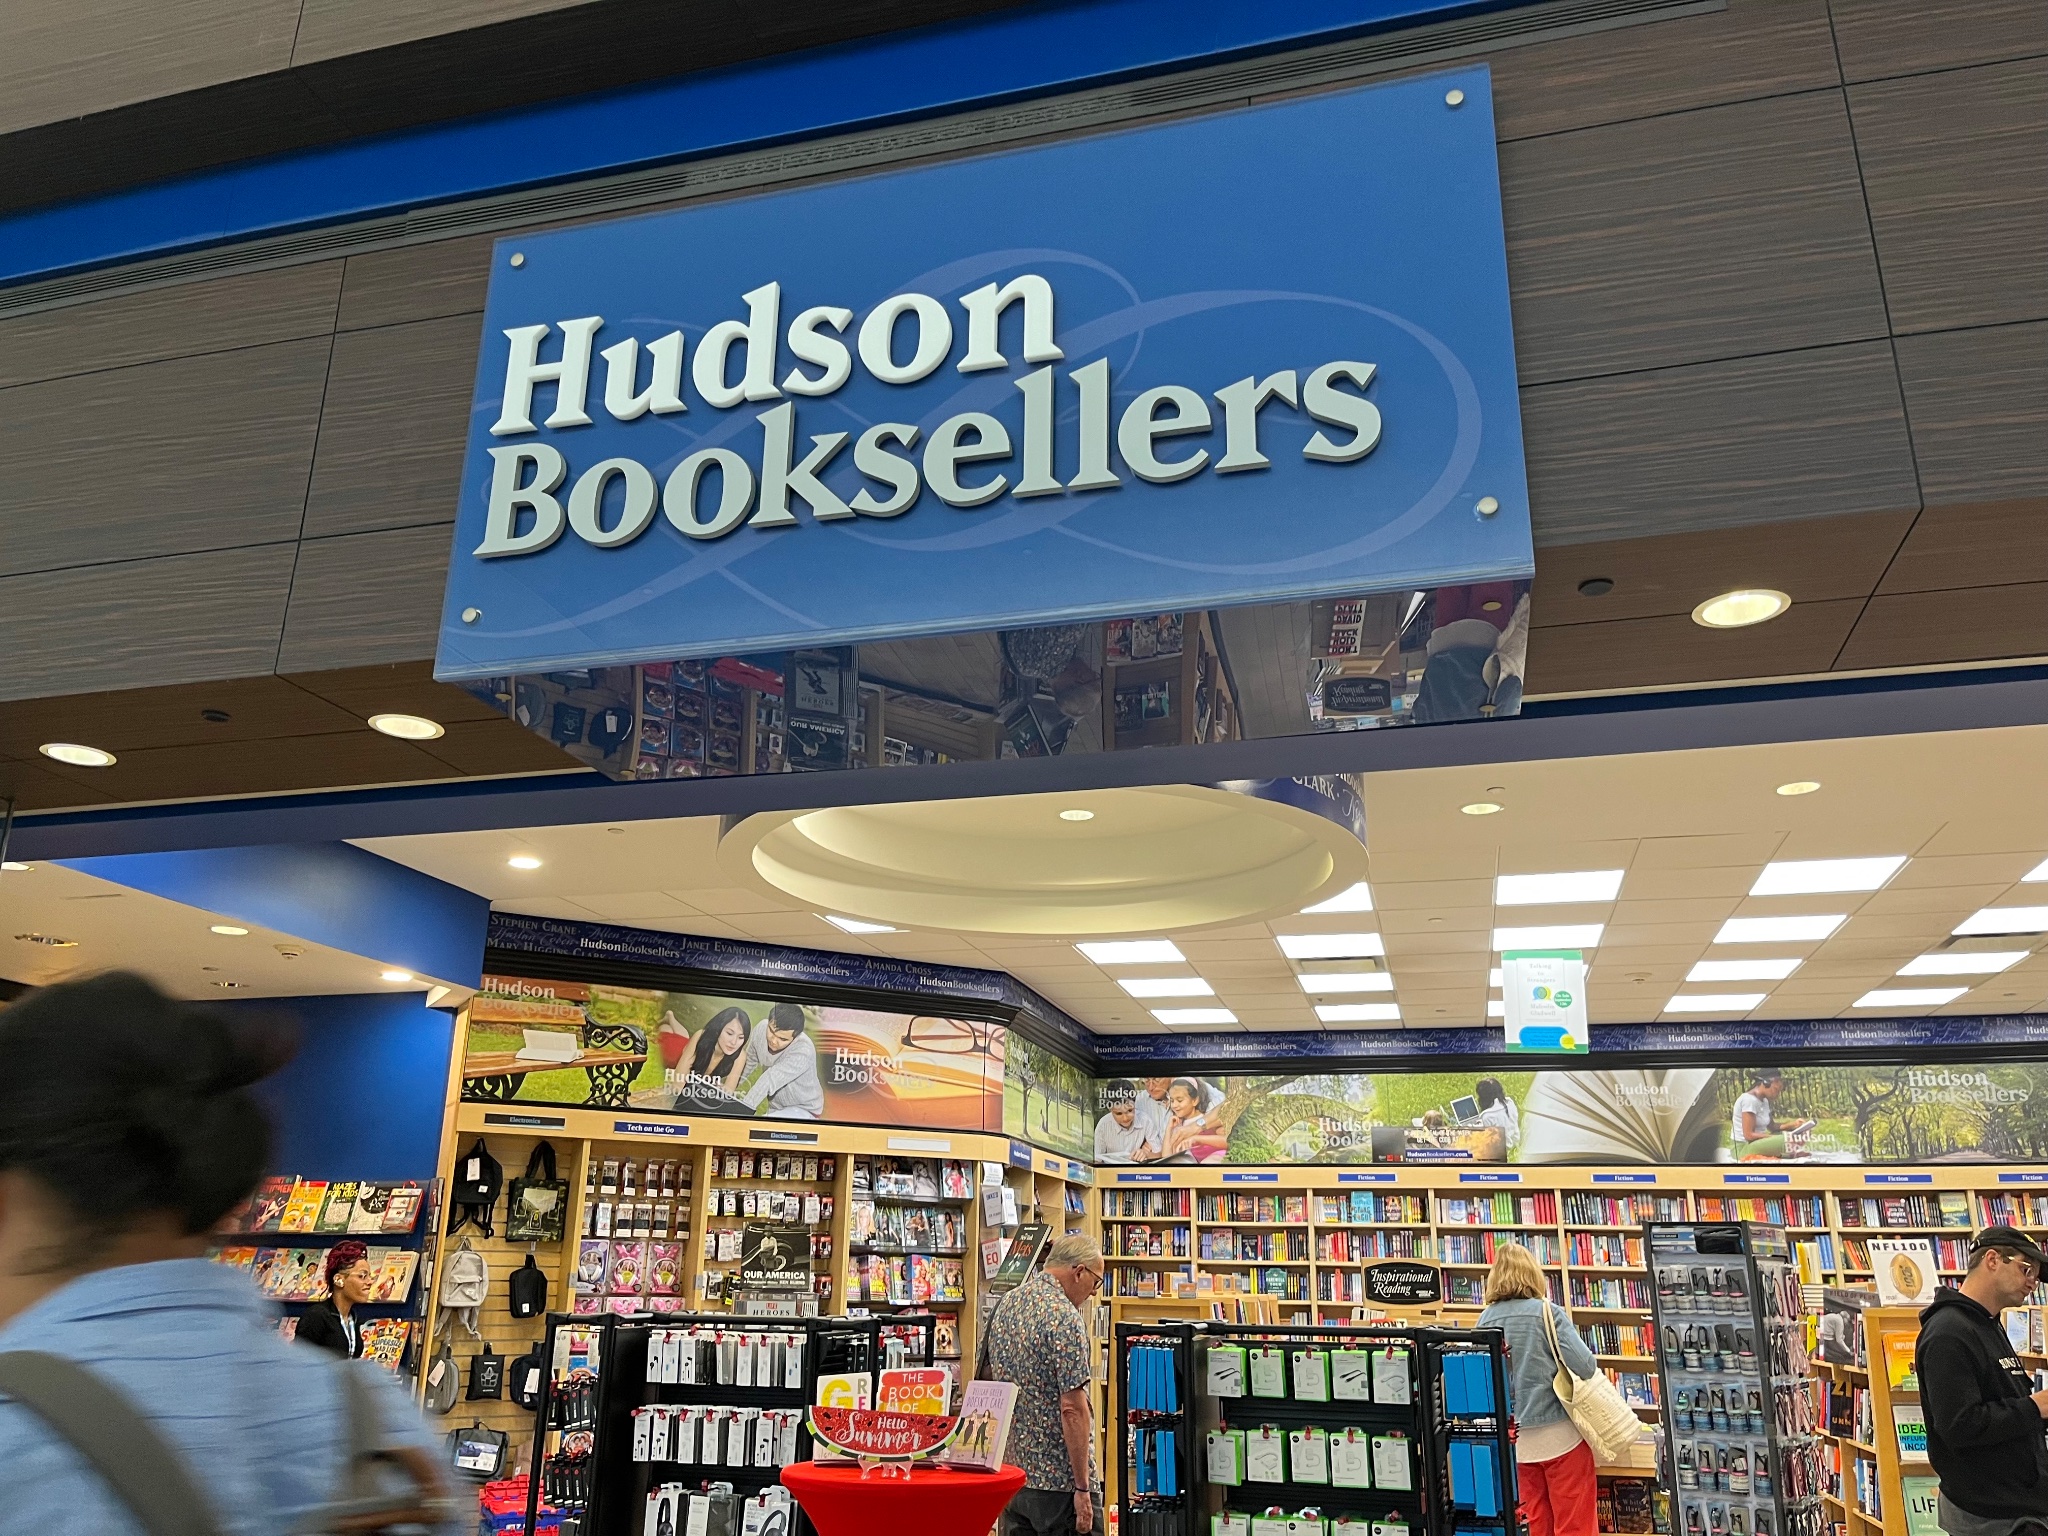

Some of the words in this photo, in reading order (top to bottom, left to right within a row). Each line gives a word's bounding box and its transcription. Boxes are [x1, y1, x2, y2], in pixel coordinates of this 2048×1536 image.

[489, 274, 1065, 437] Hudson
[474, 357, 1382, 559] Booksellers
[490, 913, 538, 930] STEPHEN
[542, 920, 577, 935] CRANE
[580, 938, 680, 958] HudsonBooksellers
[680, 937, 710, 951] JANET
[714, 941, 767, 957] EVANOVICH
[761, 958, 850, 977] HudsonBooksellers
[865, 959, 902, 973] AMANDA
[905, 963, 932, 976] CROSS
[484, 977, 556, 1000] Hudson
[920, 976, 1000, 994] HudsonBooksellers
[481, 995, 587, 1018] Booksellers
[1810, 1021, 1841, 1030] OLIVIA
[1845, 1021, 1898, 1030] GOLDSMITH
[1996, 1017, 2021, 1026] PAUL
[1645, 1025, 1680, 1034] RUSSELL
[1684, 1024, 1713, 1033] BAKER
[1841, 1030, 1932, 1039] HudsonBooksellers
[1186, 1035, 1211, 1044] PHILIP
[1213, 1034, 1235, 1043] ROTH
[1318, 1032, 1351, 1041] MARTHA
[1353, 1032, 1389, 1040] STEWART
[1668, 1033, 1754, 1042] HudsonBooksellers
[1223, 1043, 1297, 1052] HudsonBooksellers
[1361, 1040, 1438, 1048] HudsonBooksellers
[835, 1047, 903, 1070] Hudson
[664, 1068, 721, 1086] Hudson
[1908, 1070, 1988, 1087] Hudson
[663, 1084, 746, 1102] Booksellers
[1614, 1084, 1669, 1095] Hudson
[1910, 1084, 2029, 1104] Booksellers
[509, 1116, 541, 1125] Electronics
[627, 1124, 642, 1132] Tech
[654, 1125, 664, 1133] the
[665, 1125, 675, 1134] Go
[770, 1132, 798, 1140] Electronics
[1783, 1130, 1835, 1143] Hudson
[332, 1182, 357, 1191] MAZES
[326, 1190, 341, 1198] FOR
[341, 1189, 359, 1198] KIDS
[986, 1251, 999, 1266] EQ
[743, 1270, 763, 1279] OUR
[765, 1271, 806, 1280] AMERICA
[1370, 1269, 1434, 1285] Inspirational
[1373, 1282, 1412, 1298] Reading
[902, 1373, 924, 1383] THE
[889, 1385, 936, 1399] BOOK
[901, 1403, 918, 1413] OF
[966, 1396, 989, 1407] DOESN'T
[835, 1411, 922, 1450] Summer
